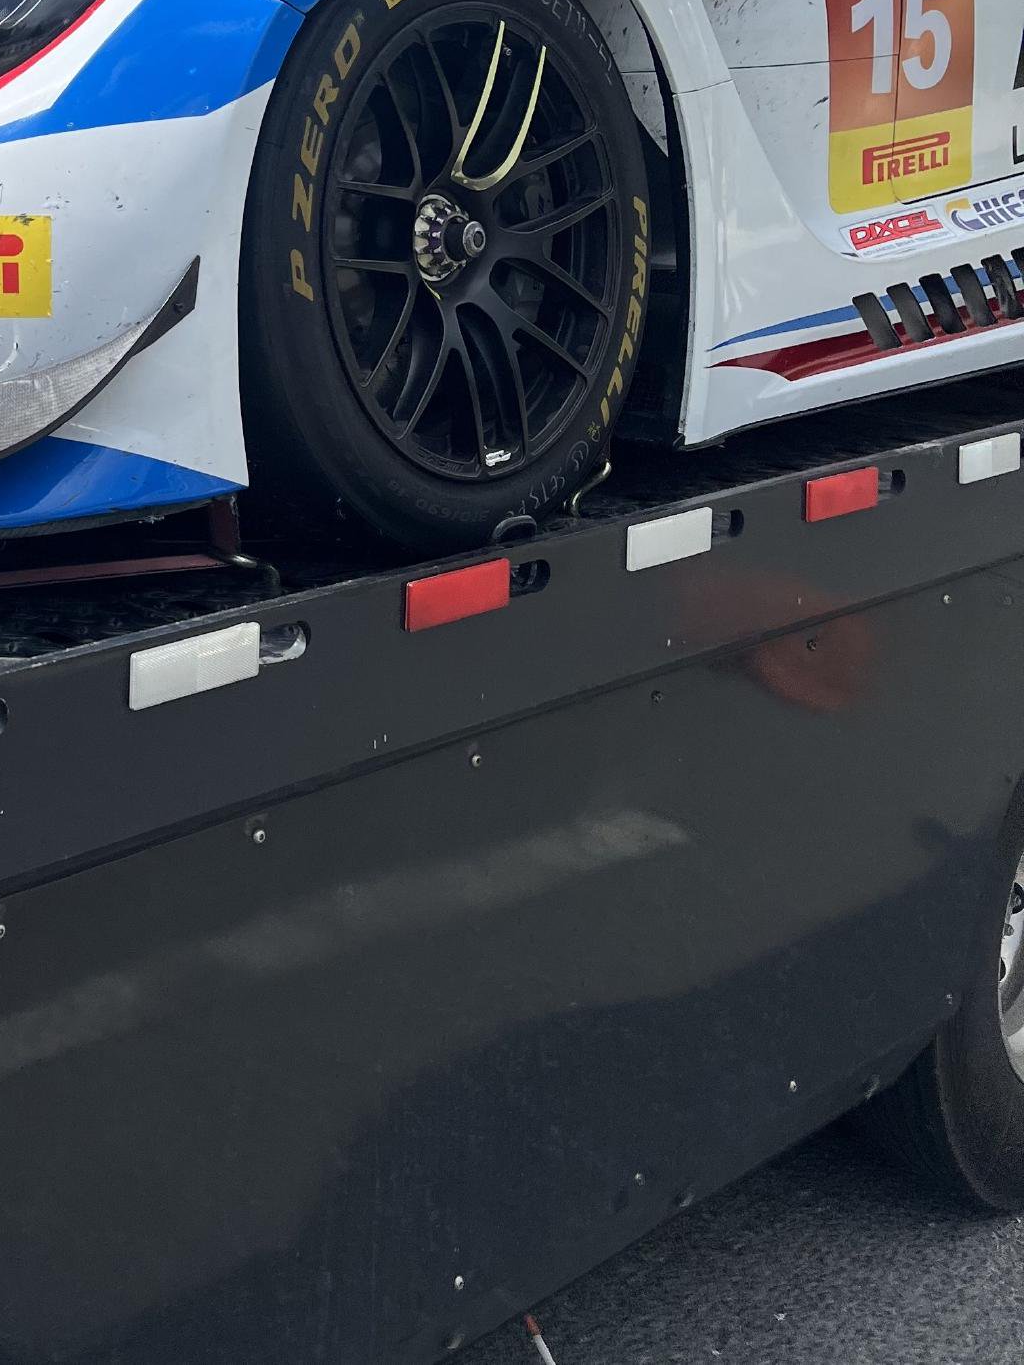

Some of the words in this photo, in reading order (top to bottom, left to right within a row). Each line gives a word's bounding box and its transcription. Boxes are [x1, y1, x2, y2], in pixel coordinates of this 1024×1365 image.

[291, 22, 361, 233] ZERO
[862, 131, 951, 185] PIRELLI
[850, 210, 943, 250] DIXCEL
[289, 248, 314, 302] P
[600, 196, 648, 428] PIRELLI
